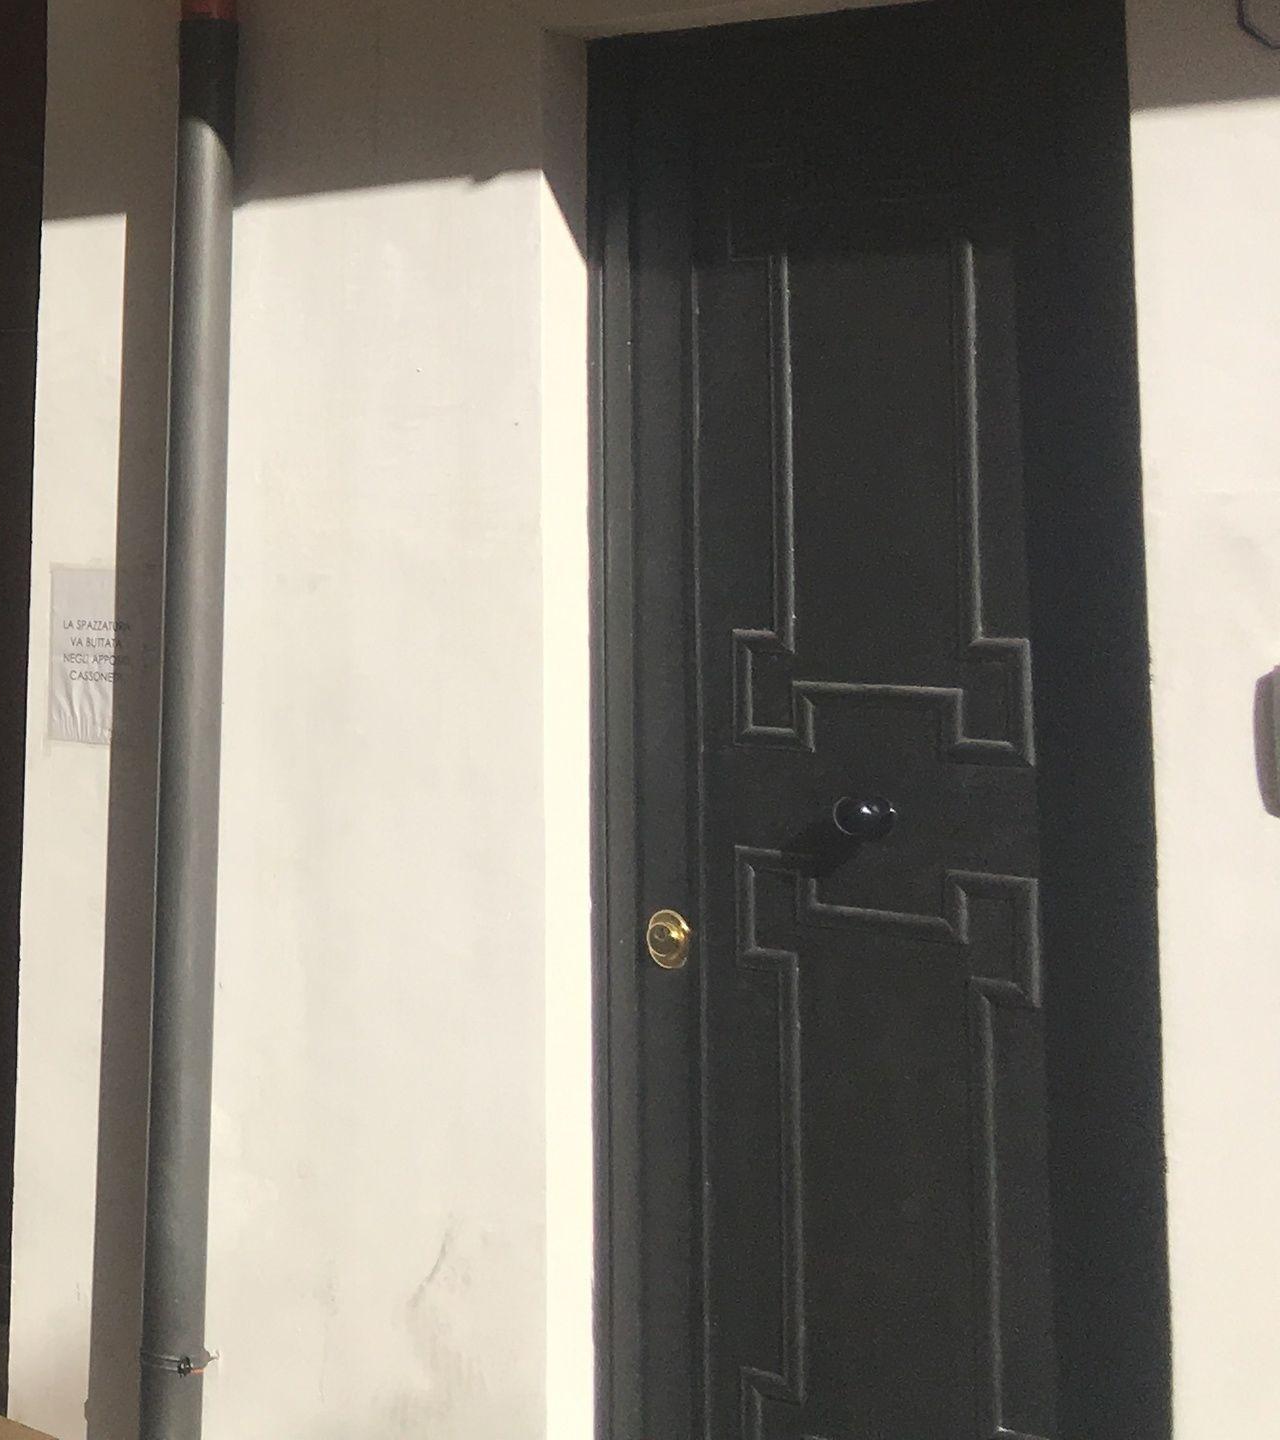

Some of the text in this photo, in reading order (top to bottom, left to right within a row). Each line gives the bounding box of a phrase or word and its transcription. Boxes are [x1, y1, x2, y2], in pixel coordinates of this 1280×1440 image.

[63, 620, 74, 630] LA
[70, 637, 122, 648] VA BUTTATA
